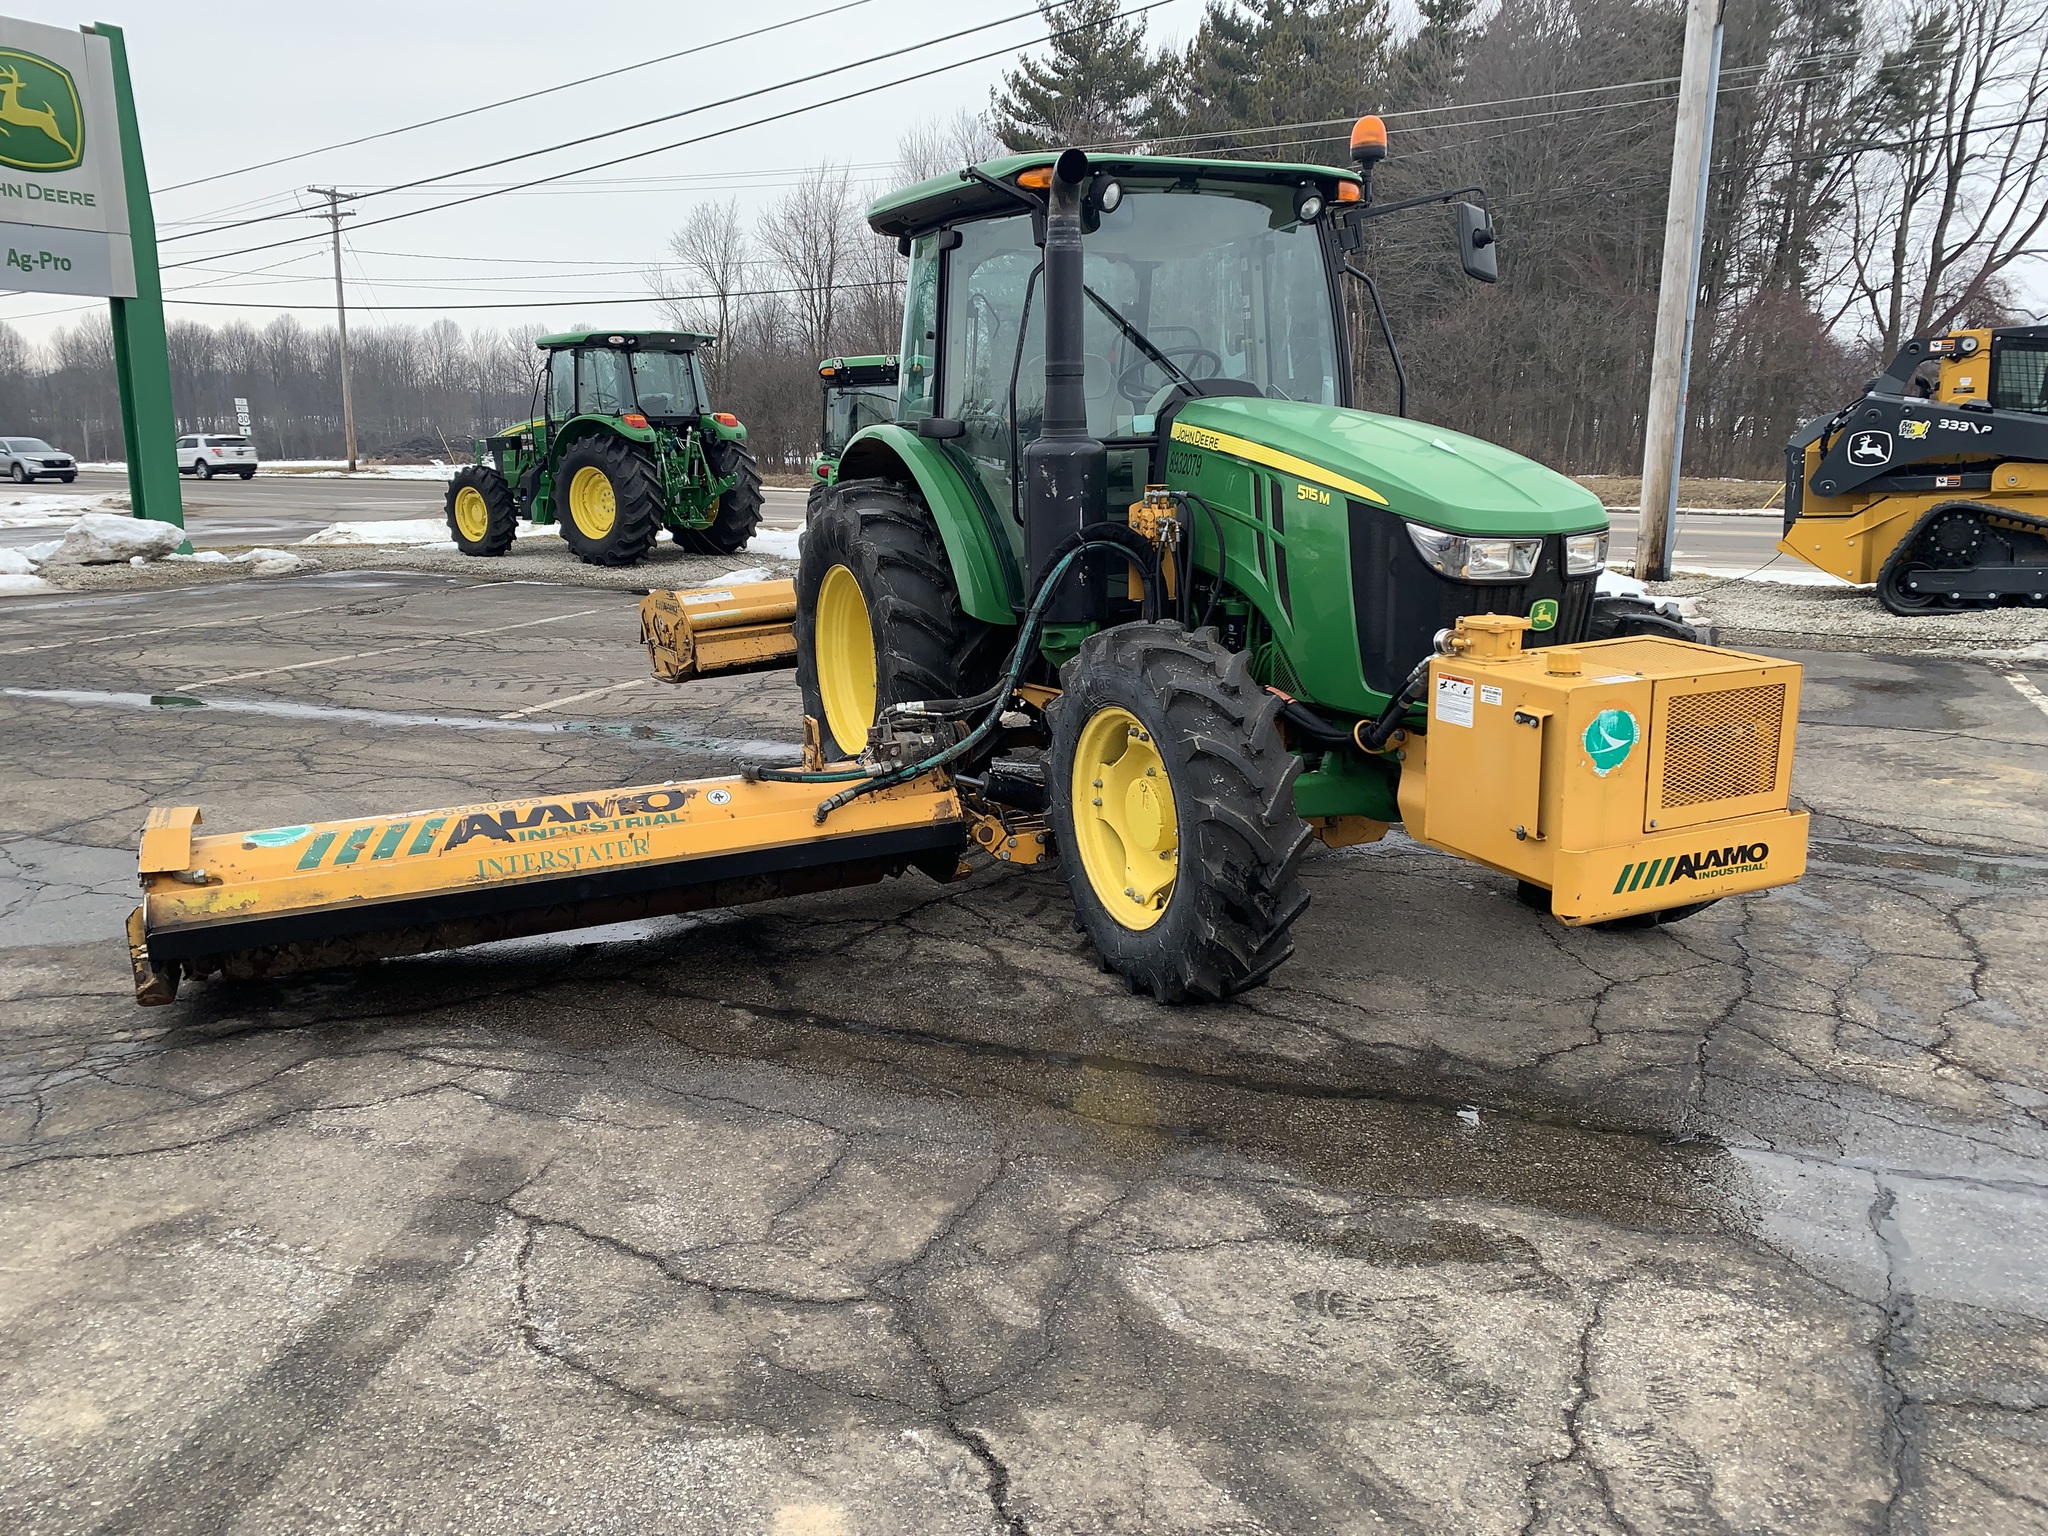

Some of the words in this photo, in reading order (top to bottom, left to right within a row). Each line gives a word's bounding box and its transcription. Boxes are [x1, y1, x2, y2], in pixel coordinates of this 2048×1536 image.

[26, 182, 96, 207] DEERE
[7, 248, 72, 272] Ag-Pro
[1176, 427, 1195, 442] JOHN
[1194, 430, 1219, 449] DEERE
[1169, 451, 1203, 477] 8932079
[443, 789, 688, 850] ALAMO
[518, 812, 685, 842] INDUSTRIAL
[476, 837, 649, 878] INTERSTATER
[1669, 842, 1769, 885] ALAMO
[1699, 863, 1766, 880] INDUSTRIAL
